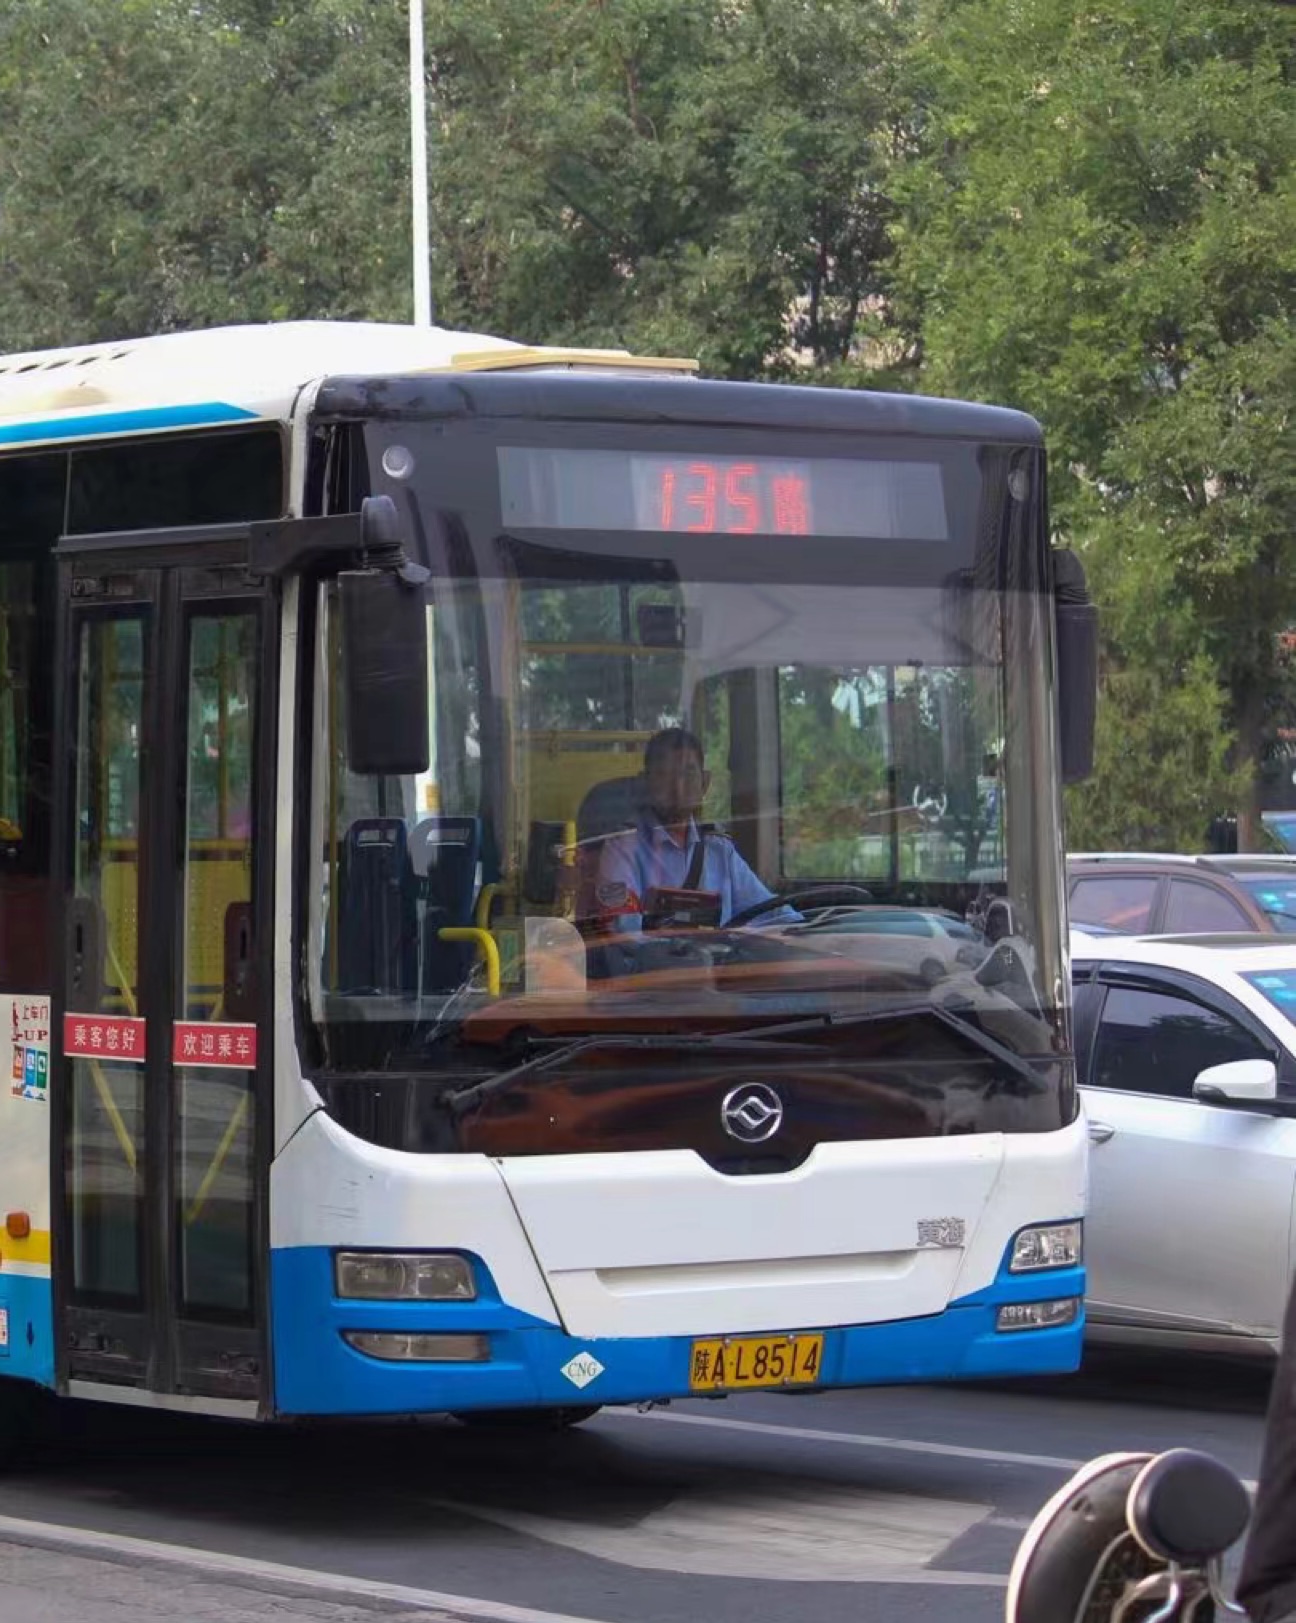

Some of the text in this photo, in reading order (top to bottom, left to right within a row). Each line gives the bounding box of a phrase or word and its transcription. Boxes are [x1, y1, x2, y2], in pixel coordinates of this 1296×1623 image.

[74, 1024, 136, 1051] 乘客您好
[183, 1033, 250, 1059] 欢迎乘车
[567, 1360, 598, 1378] CNG
